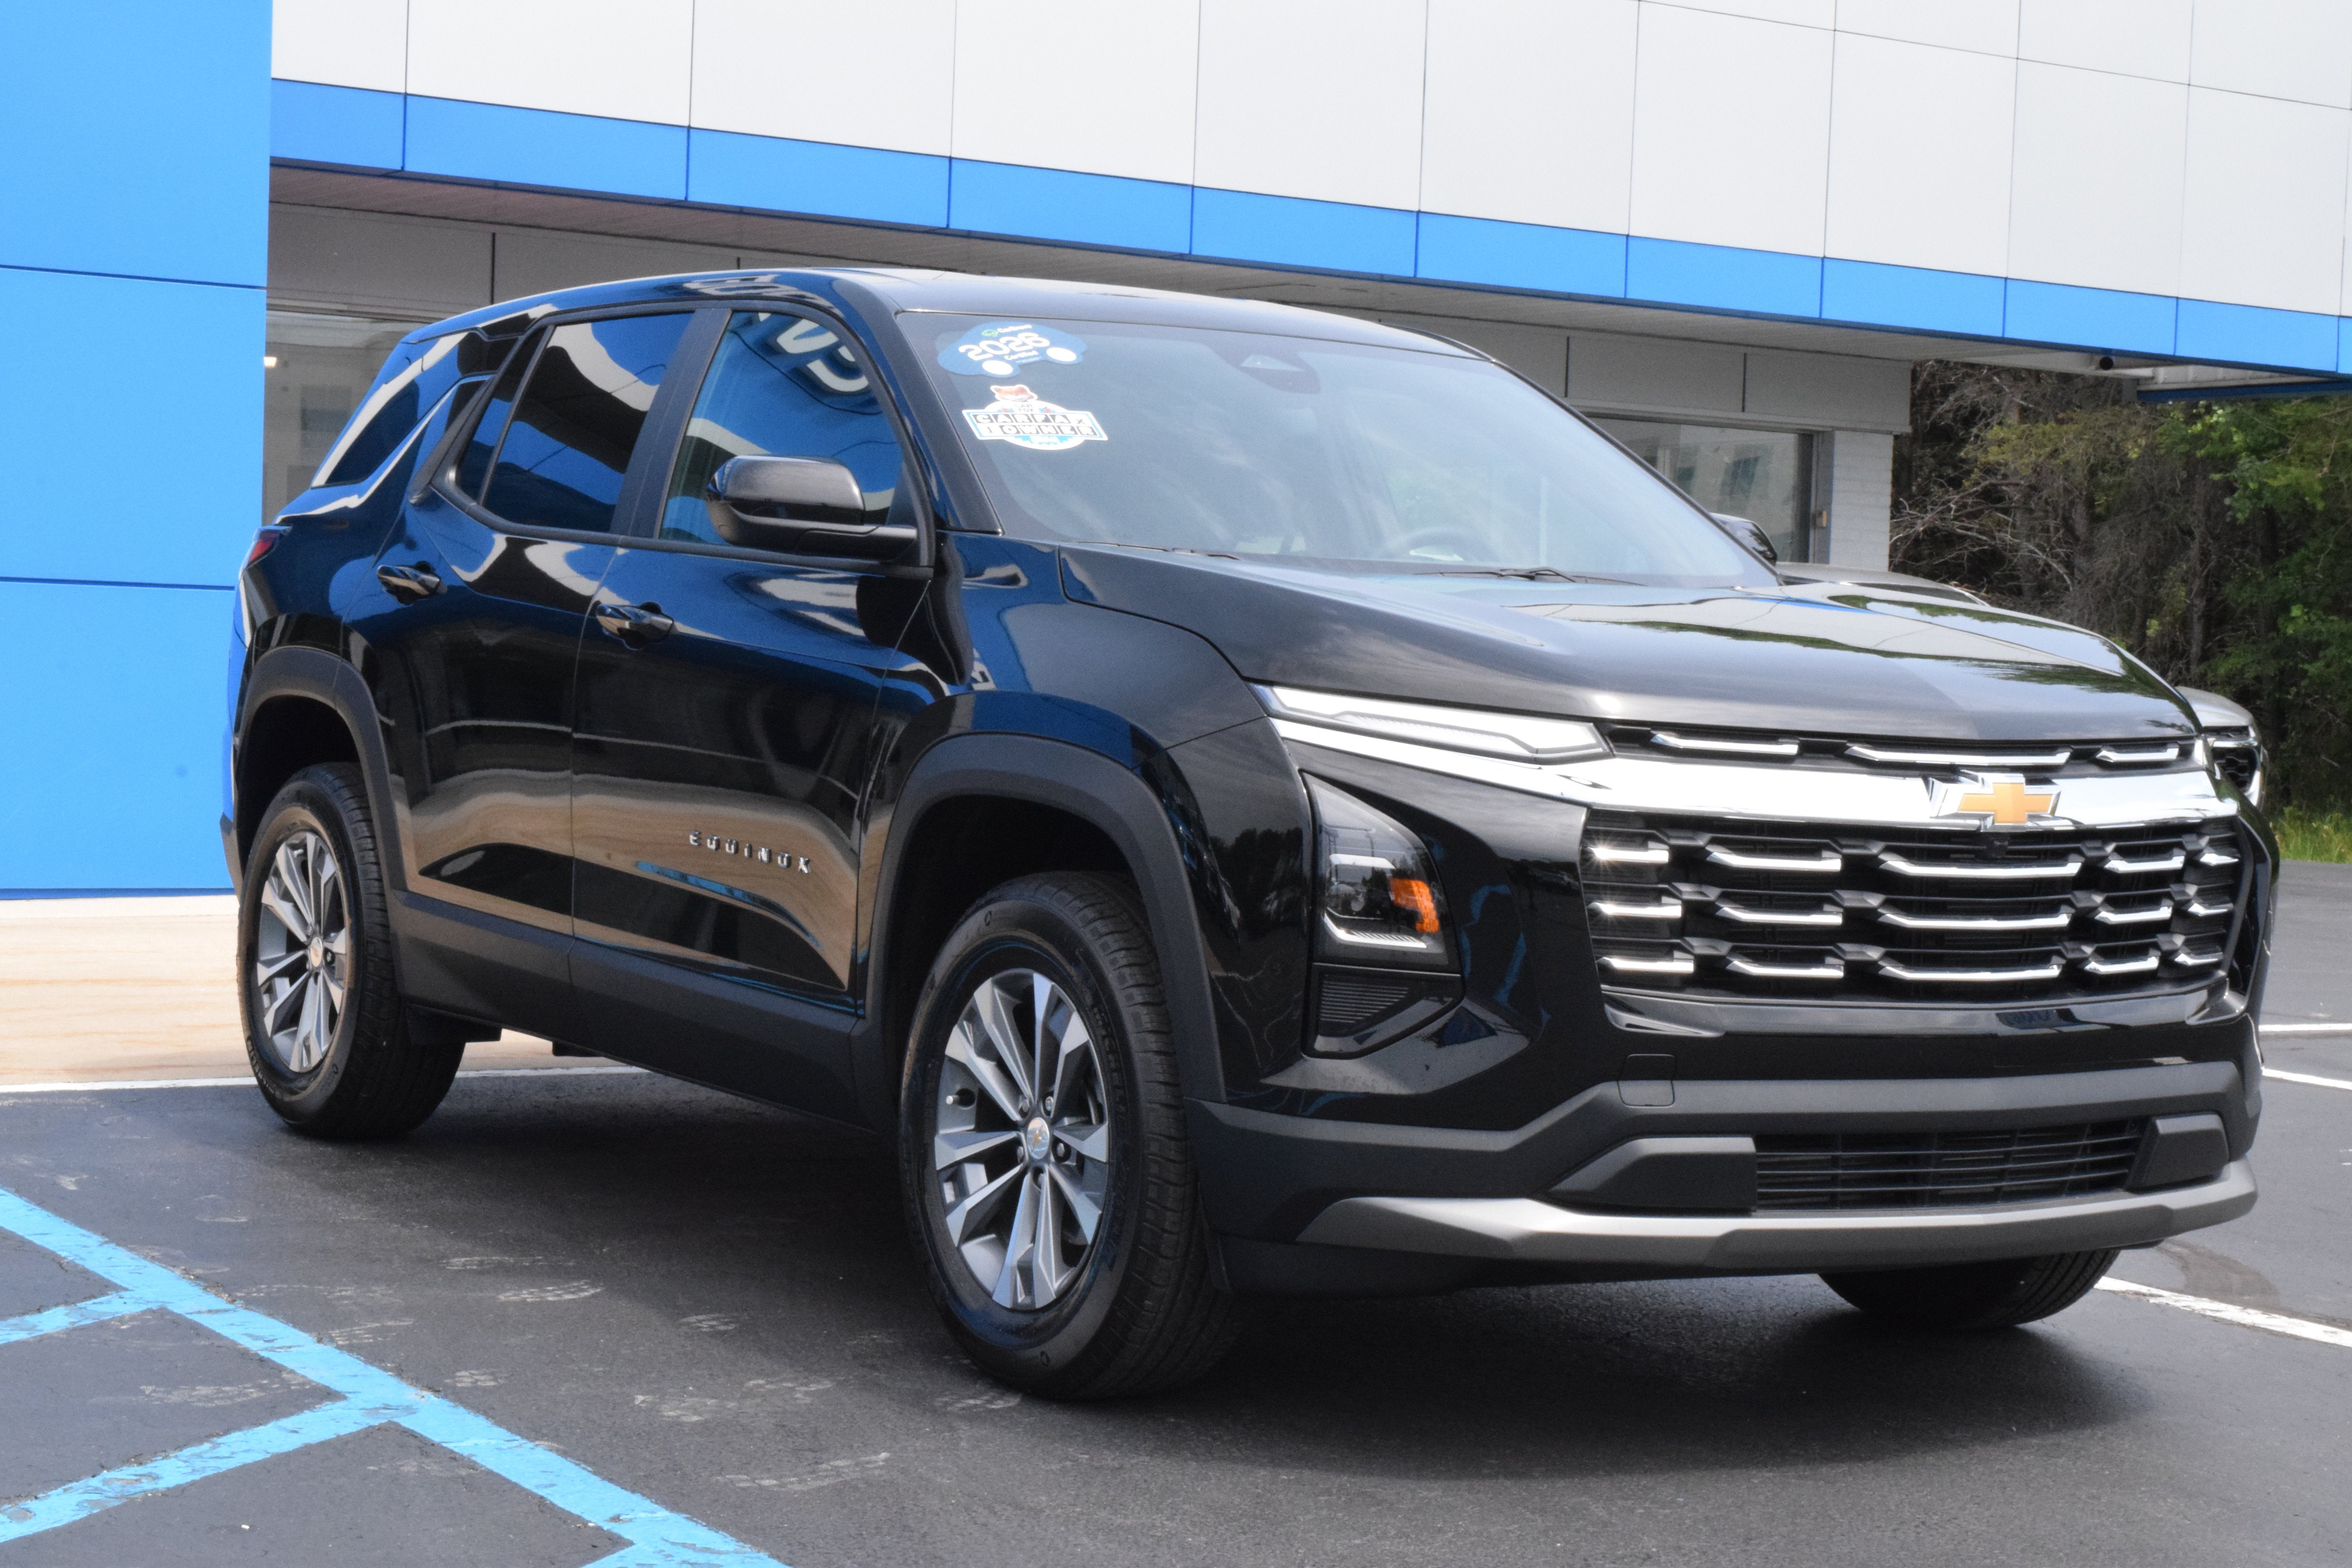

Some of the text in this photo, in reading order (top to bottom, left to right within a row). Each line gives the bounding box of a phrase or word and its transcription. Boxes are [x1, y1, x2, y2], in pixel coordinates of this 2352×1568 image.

[959, 332, 1050, 361] 2026
[972, 414, 1085, 425] CARFAX
[1000, 425, 1098, 436] OWNER
[689, 830, 811, 873] EQUINOX
